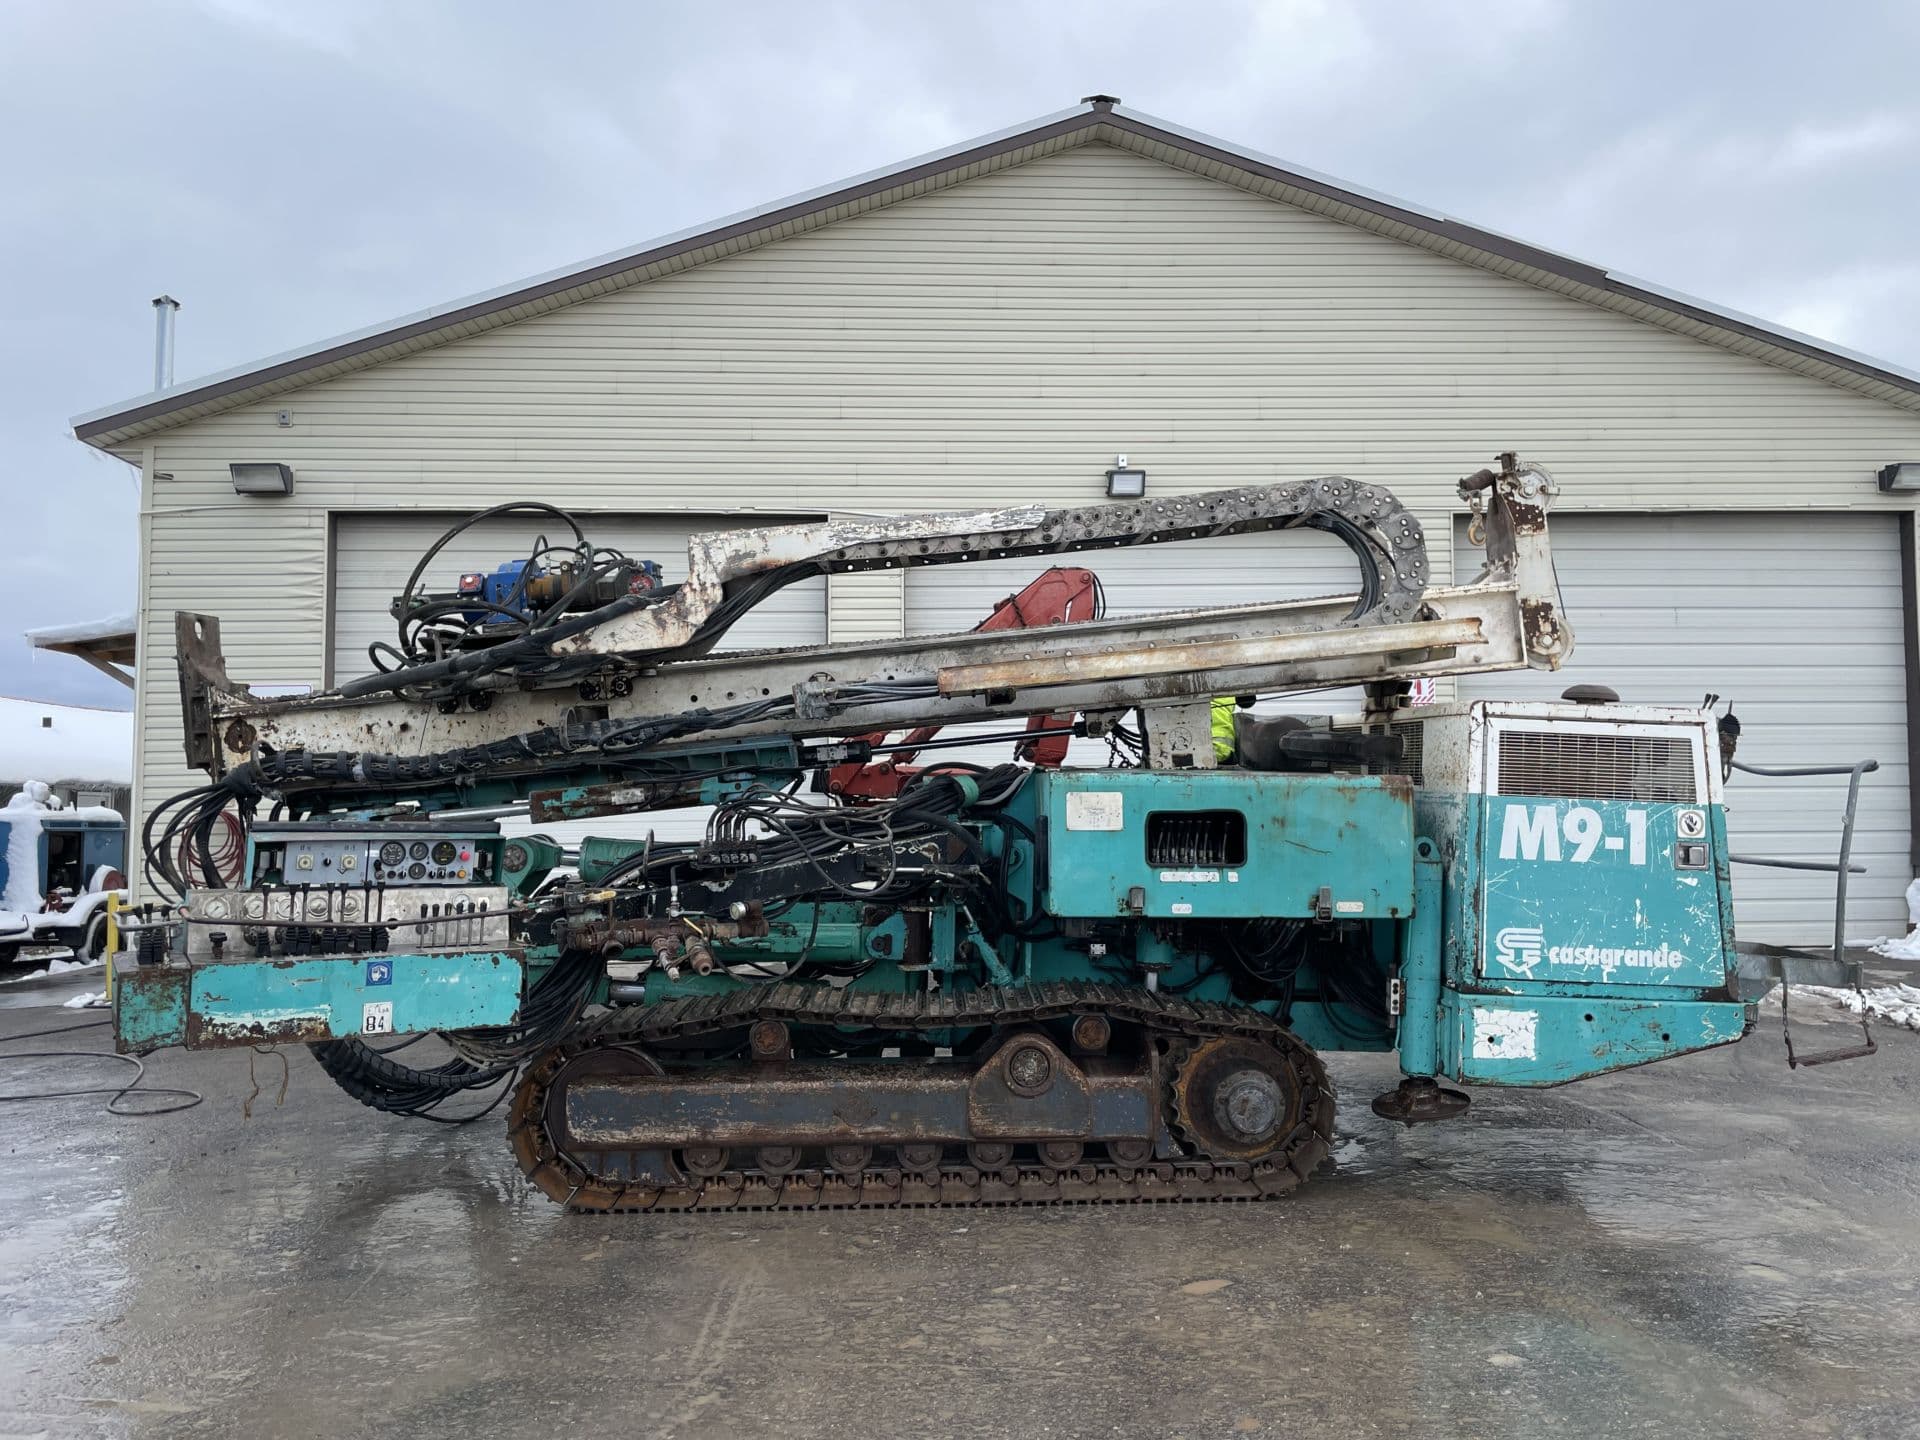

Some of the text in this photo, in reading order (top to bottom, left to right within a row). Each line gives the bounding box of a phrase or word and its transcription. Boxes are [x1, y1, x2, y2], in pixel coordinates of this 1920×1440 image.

[1500, 805, 1647, 865] M9-1
[1550, 943, 1683, 969] casagrande
[366, 1016, 384, 1031] 84
